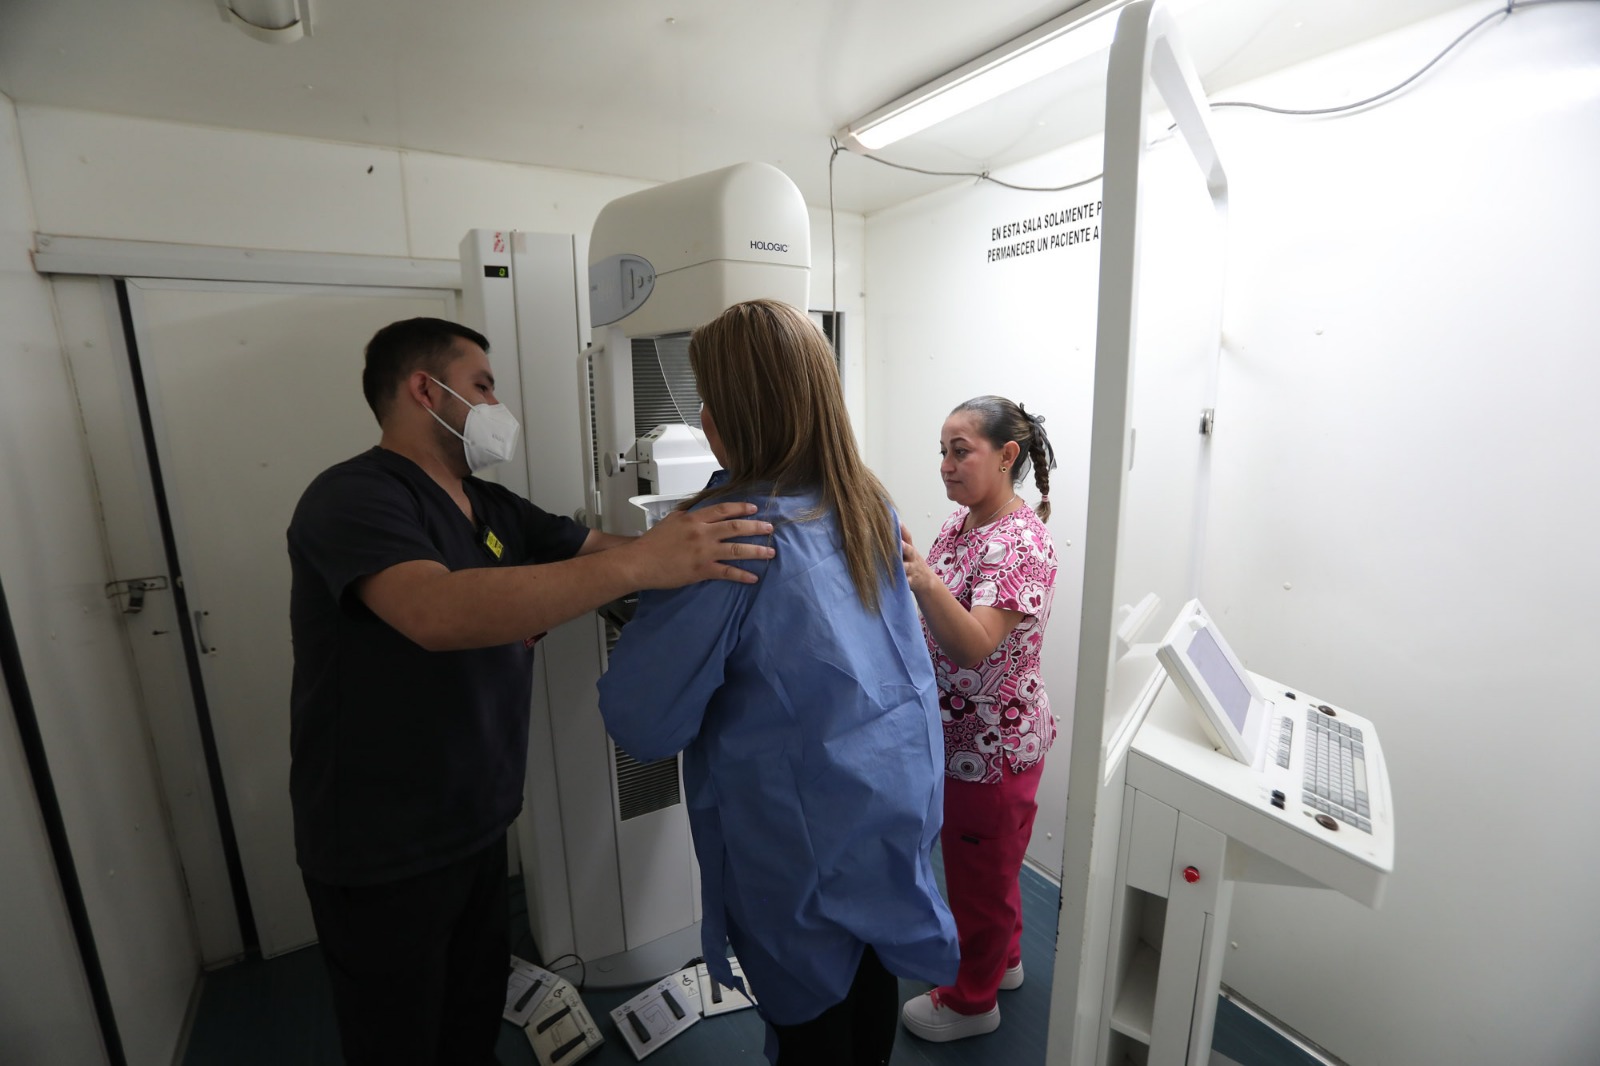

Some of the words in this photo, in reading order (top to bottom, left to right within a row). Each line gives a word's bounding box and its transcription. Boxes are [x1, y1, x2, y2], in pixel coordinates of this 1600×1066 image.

[992, 226, 1001, 241] EN
[1003, 222, 1021, 239] ESTA
[1022, 216, 1042, 234] SALA
[1044, 203, 1094, 229] SOLAMENTE
[750, 240, 788, 253] HOLOGIC
[987, 240, 1035, 263] PERMANECER
[1037, 237, 1048, 252] UN
[1050, 227, 1091, 249] PACIENTE
[1093, 225, 1099, 241] A
